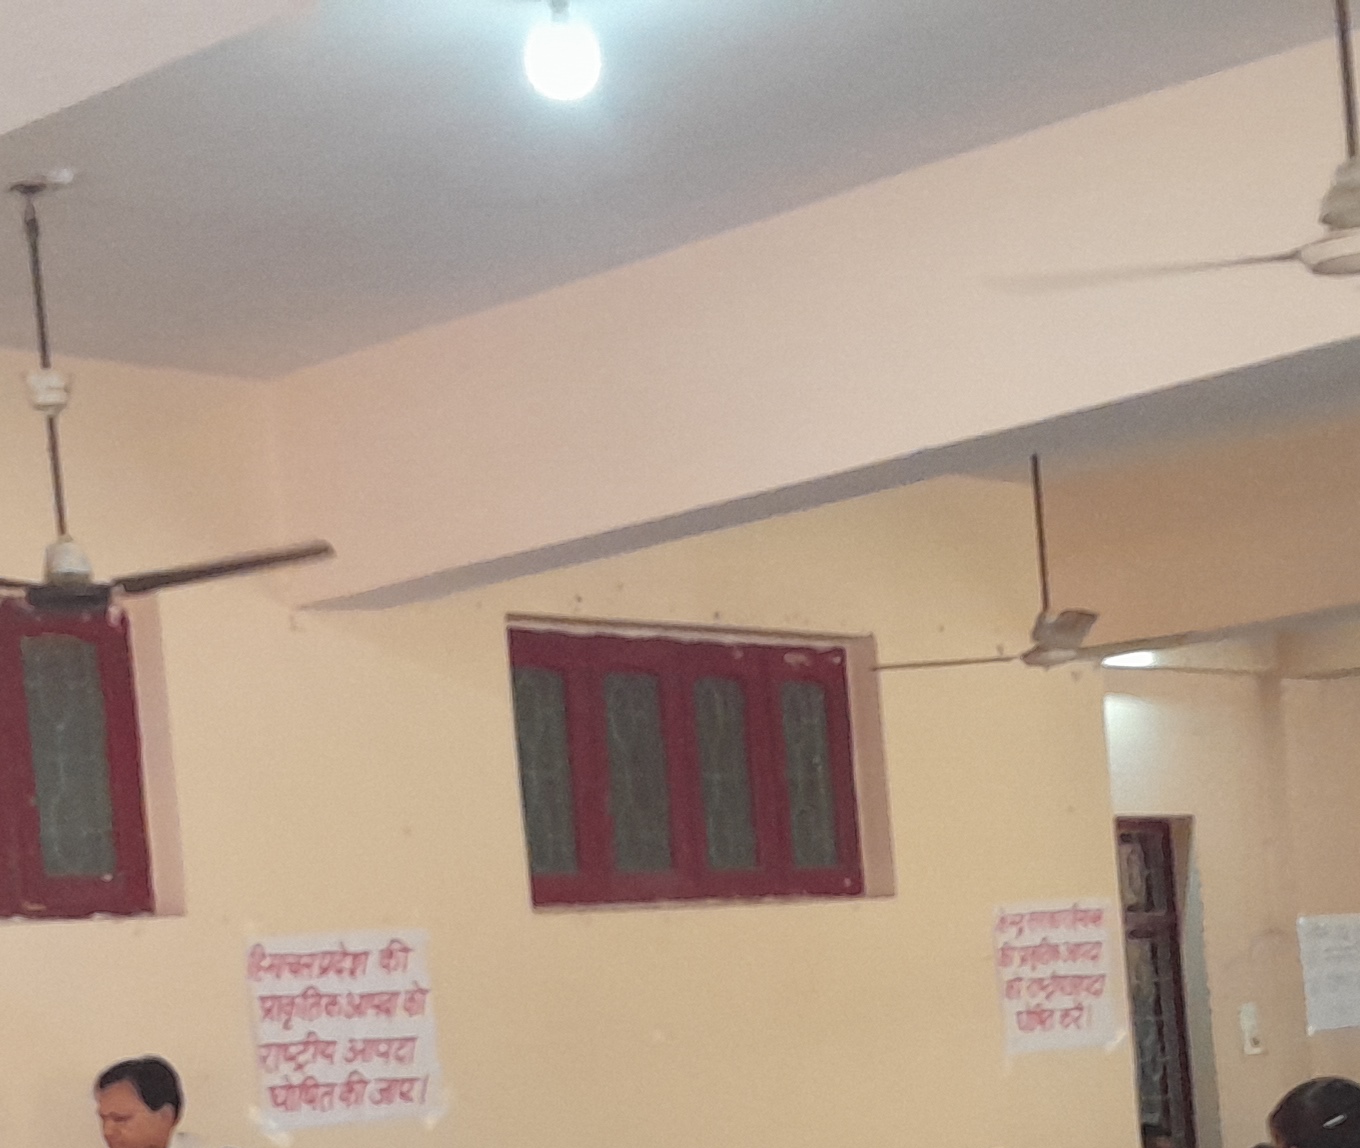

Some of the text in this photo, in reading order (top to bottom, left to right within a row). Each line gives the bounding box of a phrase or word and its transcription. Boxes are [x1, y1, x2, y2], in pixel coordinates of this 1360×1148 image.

[378, 937, 415, 975] की
[402, 980, 431, 1018] को
[343, 1035, 419, 1065] आपदा
[338, 1069, 370, 1109] की
